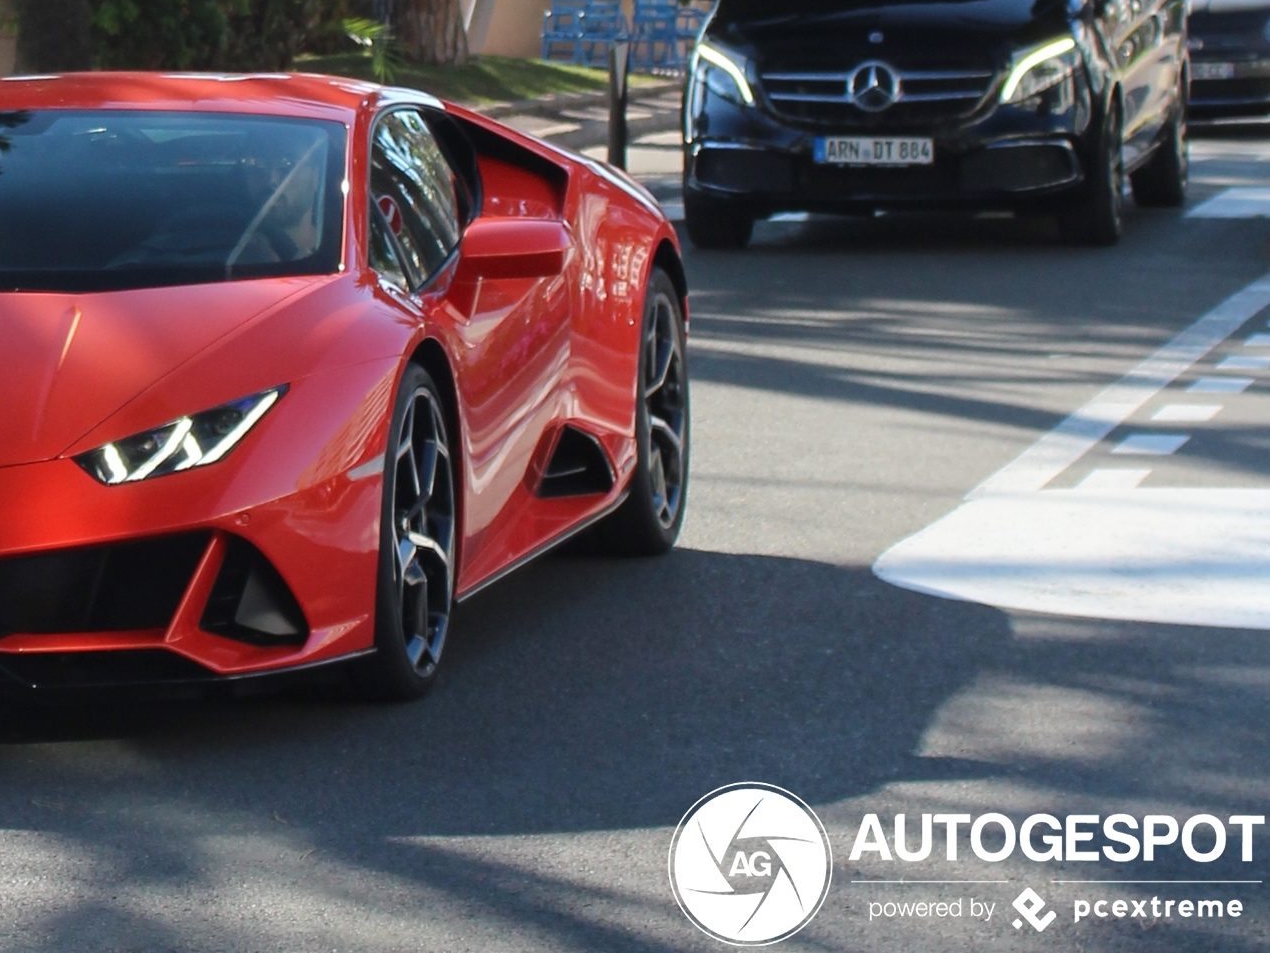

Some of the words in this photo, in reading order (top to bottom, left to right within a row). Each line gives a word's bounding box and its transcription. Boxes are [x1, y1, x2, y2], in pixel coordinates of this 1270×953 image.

[828, 141, 859, 159] ARN
[874, 141, 893, 159] DT
[900, 141, 929, 159] 884
